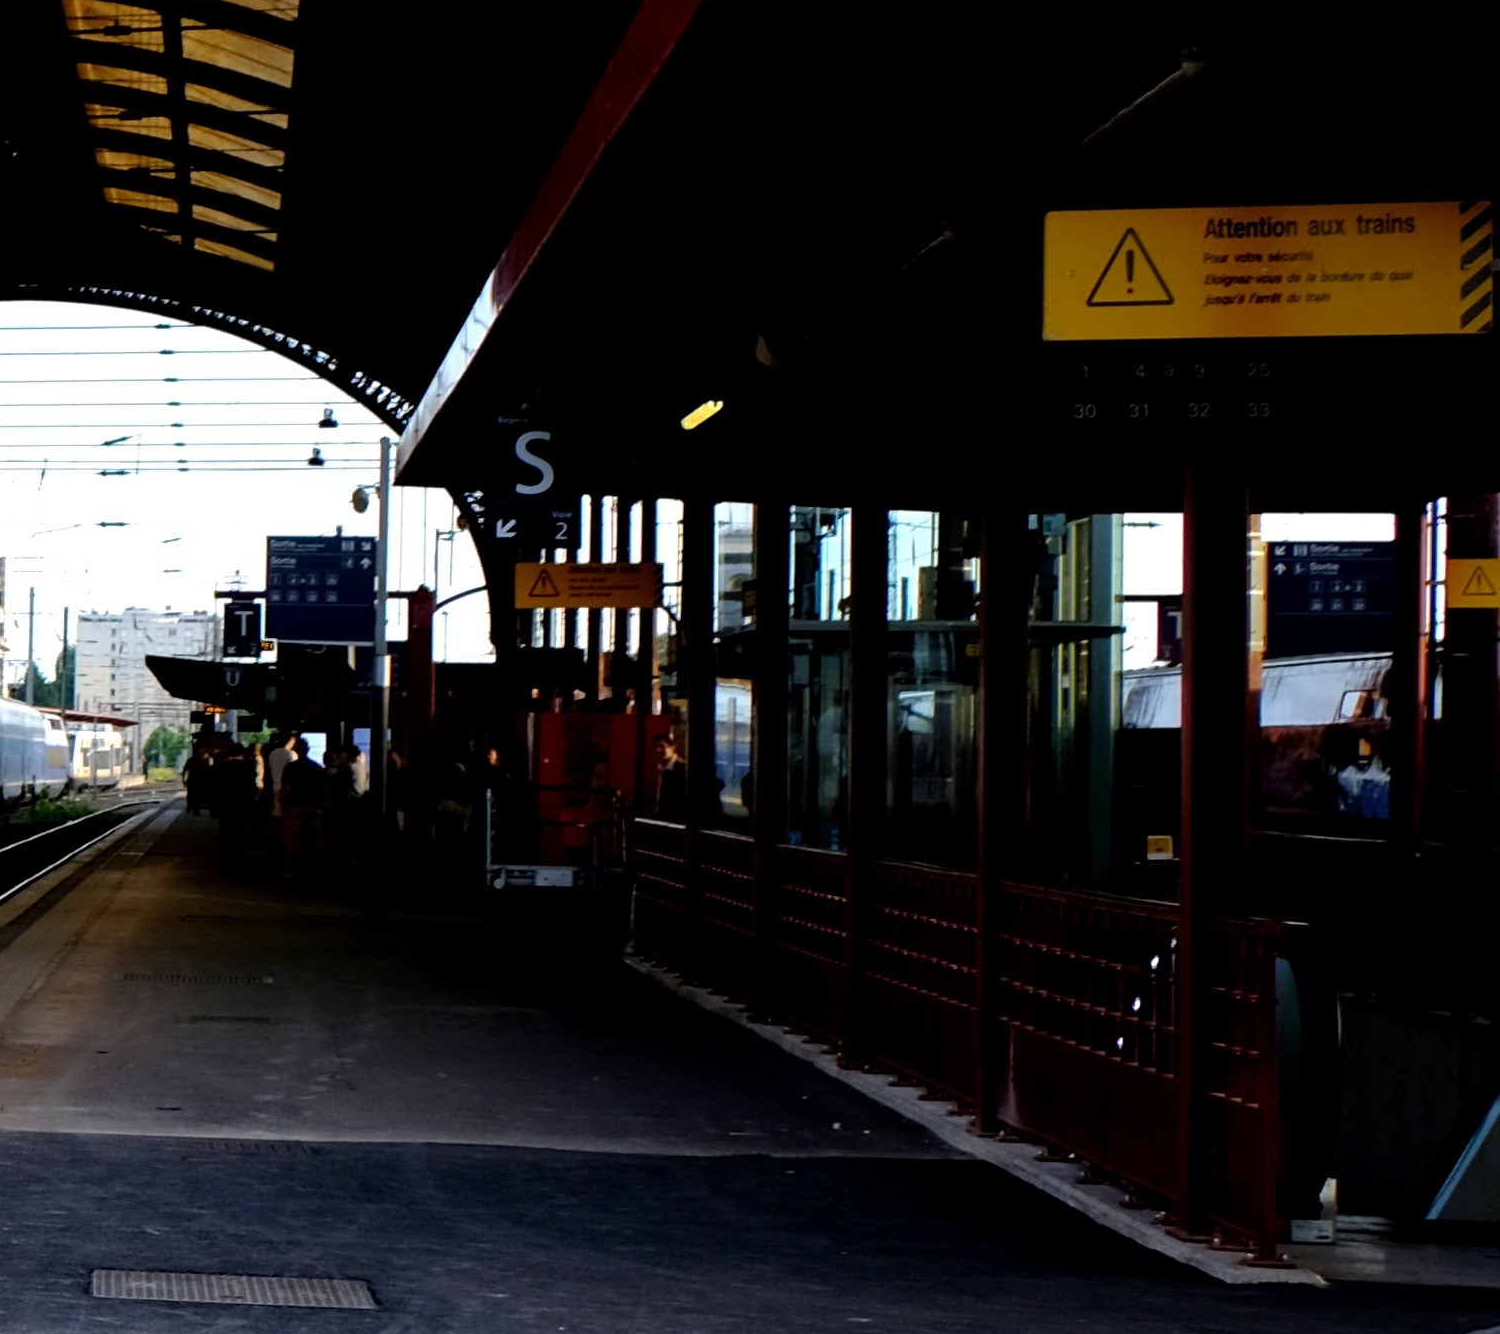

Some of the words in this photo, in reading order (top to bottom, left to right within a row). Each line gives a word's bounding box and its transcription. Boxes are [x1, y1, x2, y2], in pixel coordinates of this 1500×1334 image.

[1204, 215, 1298, 239] Attention
[1308, 217, 1345, 236] aux
[1356, 213, 1416, 234] trains
[1203, 253, 1228, 263] Pour
[1235, 252, 1262, 263] votre
[1287, 273, 1300, 283] de
[1306, 272, 1316, 282] la
[1320, 271, 1365, 282] bordure
[1370, 270, 1384, 281] du
[1389, 271, 1414, 283] quai
[1286, 292, 1300, 303] du
[1304, 292, 1331, 303] train
[1135, 365, 1146, 378] 4
[1194, 364, 1204, 378] 9
[1248, 364, 1270, 377] 25
[1073, 404, 1096, 419] 30
[1129, 404, 1148, 418] 31
[1188, 403, 1210, 417] 32
[1248, 402, 1270, 417] 33
[515, 431, 554, 495] S
[551, 510, 572, 518] Voie
[555, 522, 568, 540] 2
[234, 611, 254, 636] T
[225, 671, 240, 687] U
